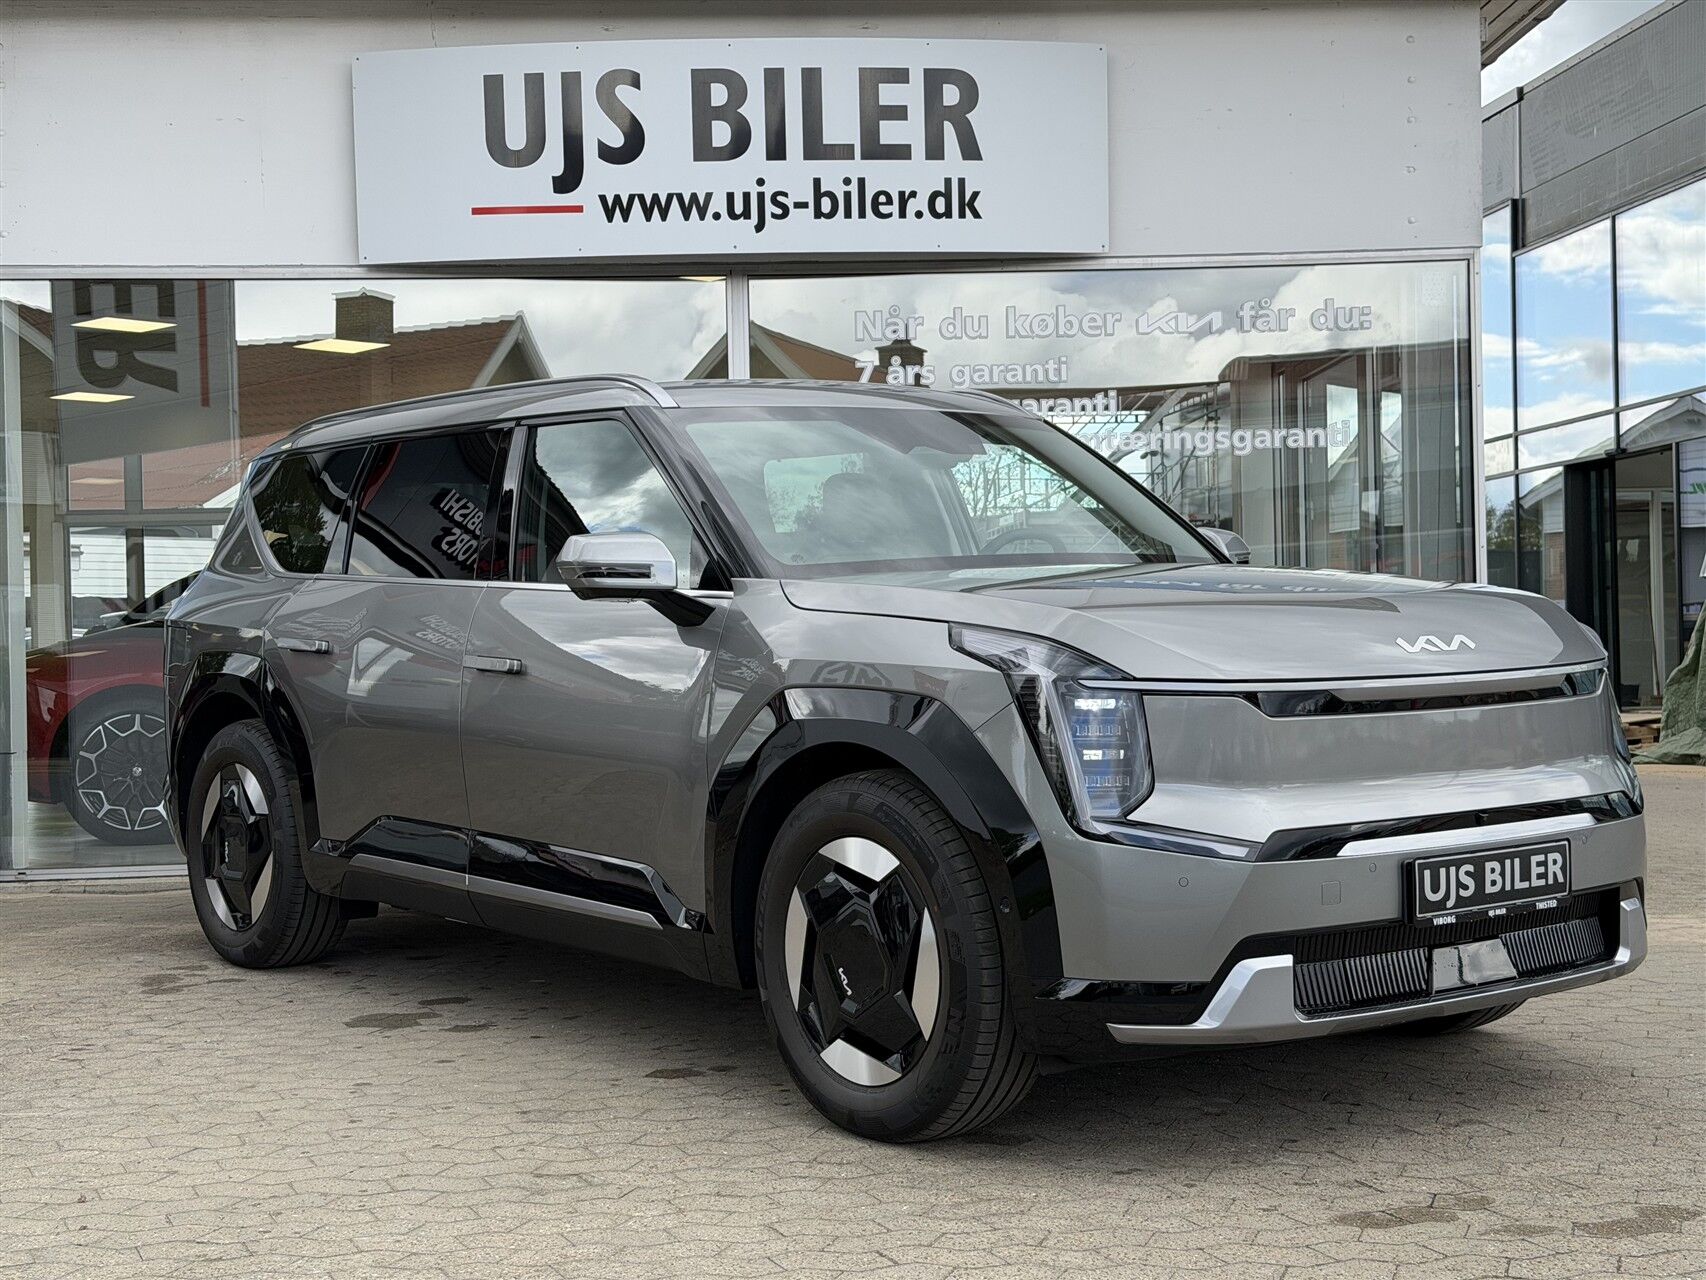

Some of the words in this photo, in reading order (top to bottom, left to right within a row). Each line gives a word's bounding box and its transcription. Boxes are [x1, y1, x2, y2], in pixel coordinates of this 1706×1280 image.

[483, 68, 645, 195] UJS
[691, 67, 984, 162] BILER
[598, 176, 984, 234] www.ujs-biler.dk
[854, 305, 924, 342] Når
[939, 307, 989, 340] du
[1005, 304, 1121, 339] køber
[1237, 298, 1296, 333] får
[1310, 299, 1372, 331] du:
[855, 361, 875, 383] 7
[886, 355, 936, 385] års
[950, 356, 1069, 387] garanti
[1010, 389, 1118, 417] aranti
[1395, 634, 1476, 653] KIA
[1423, 863, 1475, 908] UJS
[1485, 852, 1565, 894] BILER
[1433, 915, 1456, 926] VIBORG
